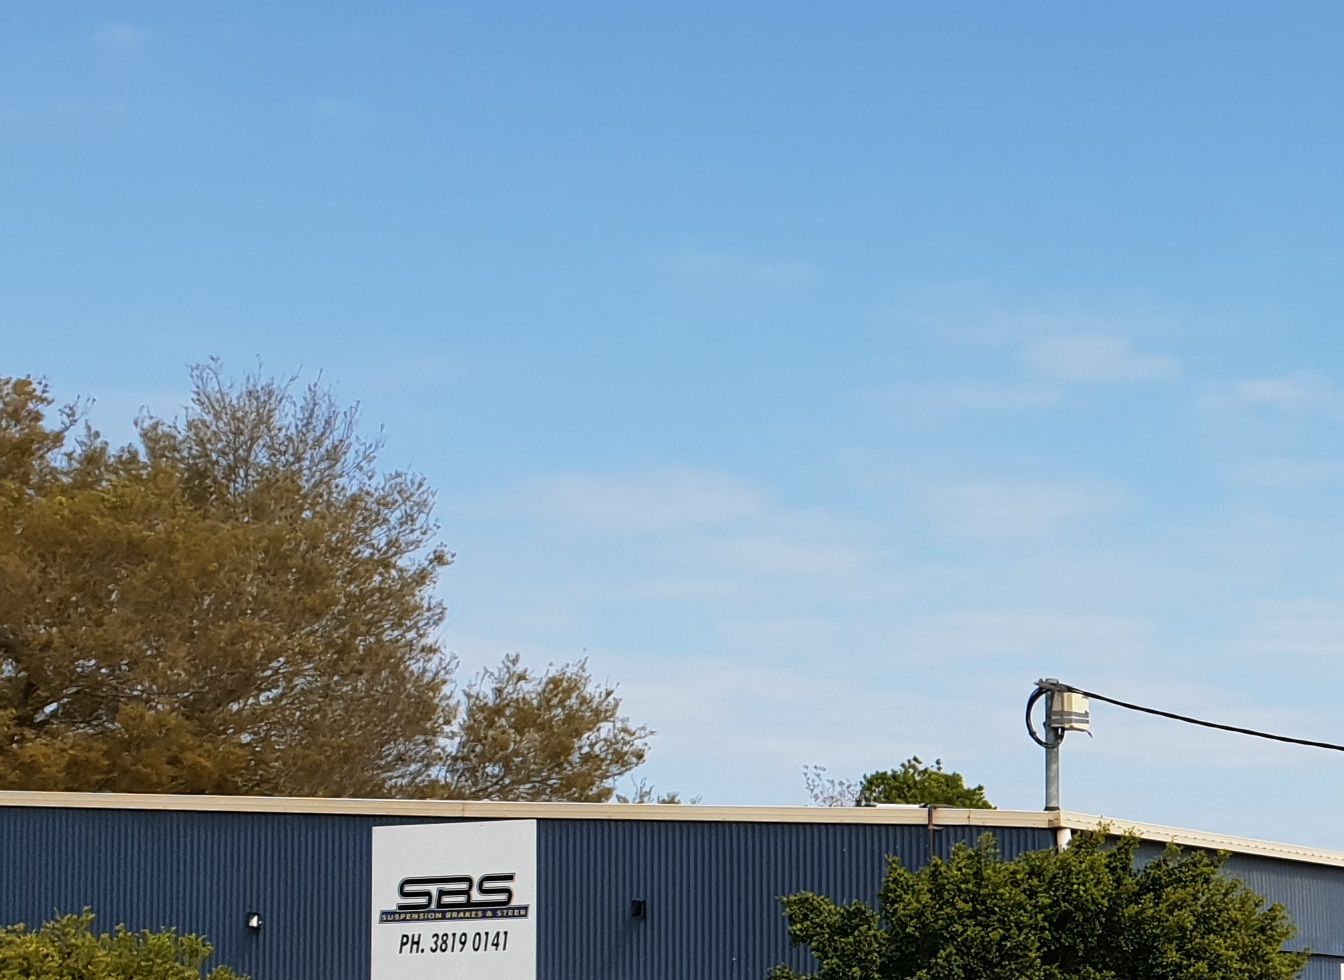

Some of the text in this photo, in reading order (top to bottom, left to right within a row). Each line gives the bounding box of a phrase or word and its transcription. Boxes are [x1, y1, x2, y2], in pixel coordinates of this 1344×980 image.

[397, 872, 516, 912] SBS
[382, 912, 442, 921] SUSPENSION
[445, 910, 483, 919] BRAKES
[497, 909, 527, 917] STEER
[399, 931, 508, 954] PH. 3819 0141
